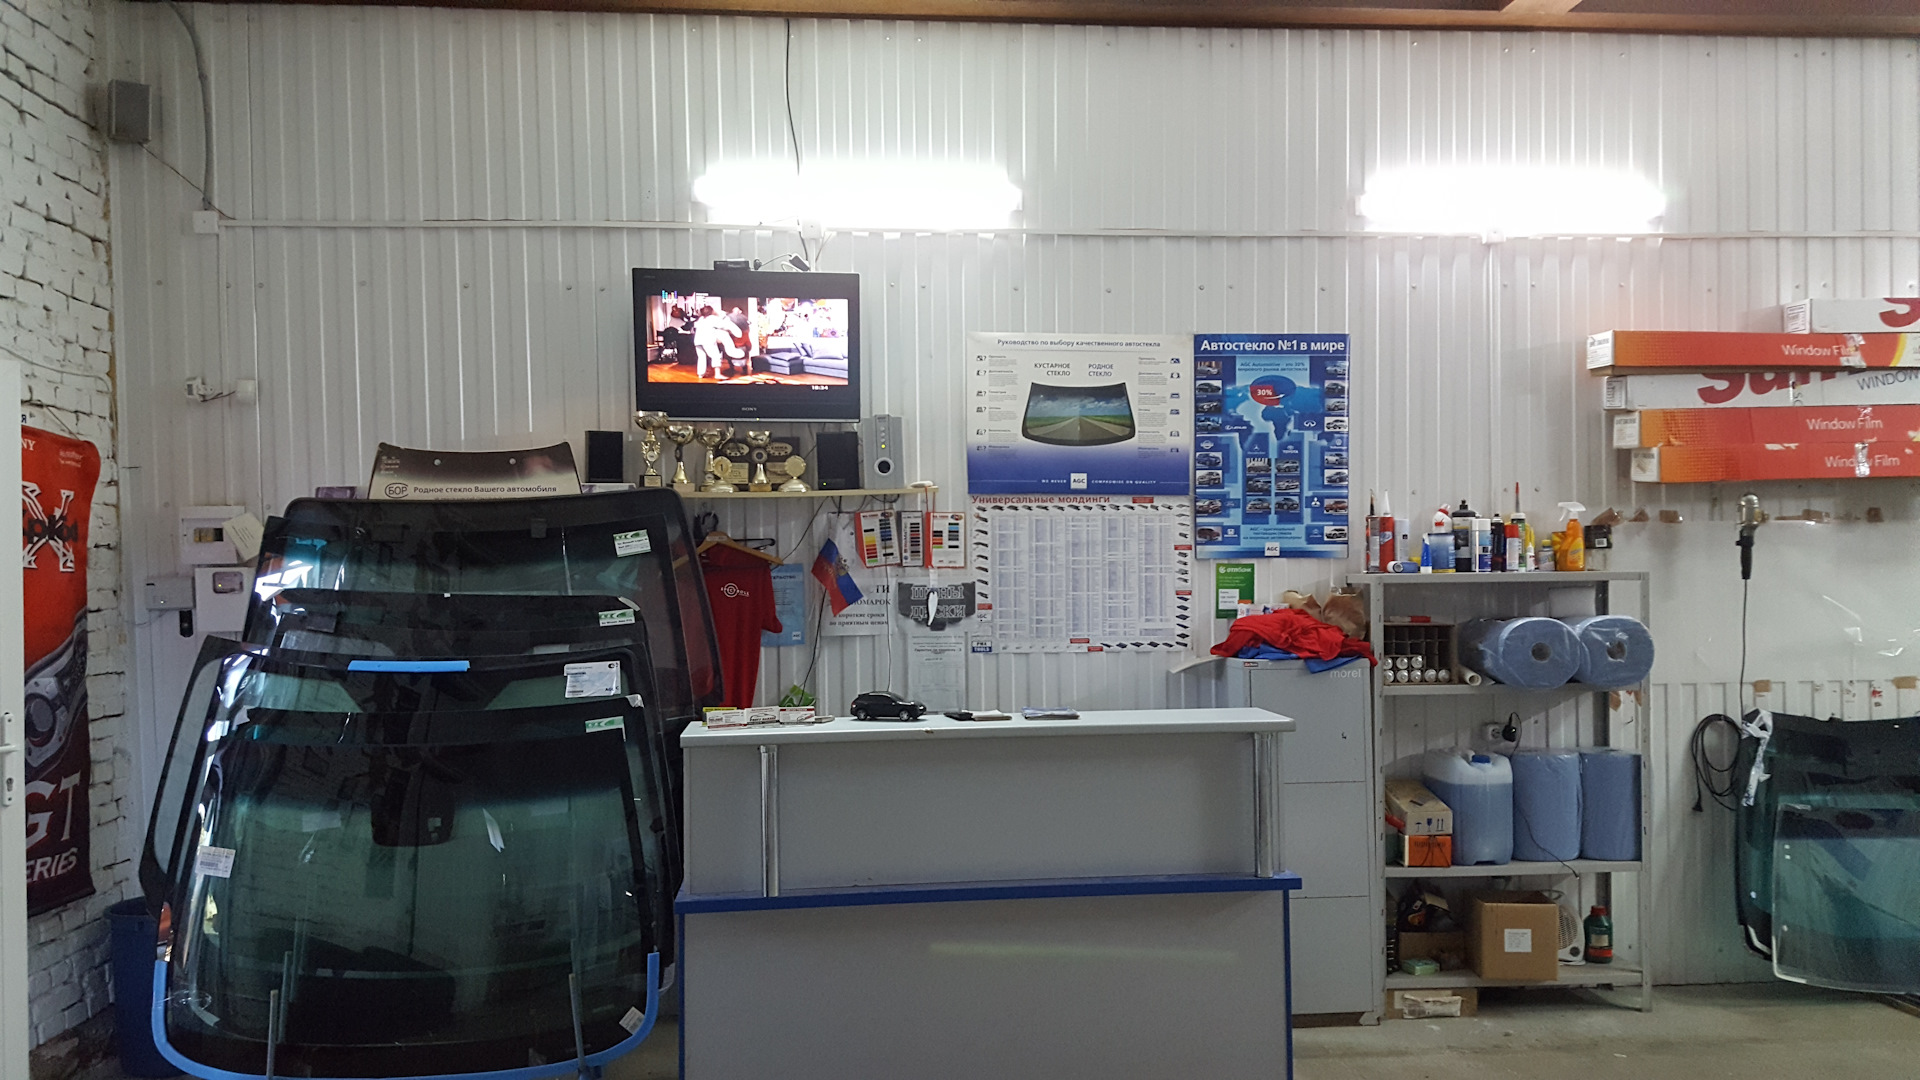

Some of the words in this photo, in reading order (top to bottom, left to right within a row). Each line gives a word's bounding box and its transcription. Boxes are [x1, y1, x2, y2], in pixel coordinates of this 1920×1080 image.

[997, 338, 1039, 347] Руководство
[1050, 340, 1074, 348] выбору
[1200, 339, 1275, 351] Автостекло
[1277, 339, 1298, 351] №1
[1300, 343, 1307, 351] в
[1310, 342, 1345, 353] мире
[1781, 344, 1831, 356] Window
[1256, 388, 1273, 397] 30%
[1807, 418, 1856, 430] Window
[1857, 418, 1883, 429] Film
[1874, 454, 1900, 467] Film
[388, 486, 408, 496] БОР
[413, 486, 444, 494] Родное
[506, 485, 557, 493] автомобиля
[972, 496, 1055, 504] Универсальные
[1058, 496, 1110, 504] молдинги
[910, 586, 965, 600] ШНЫ
[1330, 668, 1362, 678] morel
[23, 769, 81, 847] GT
